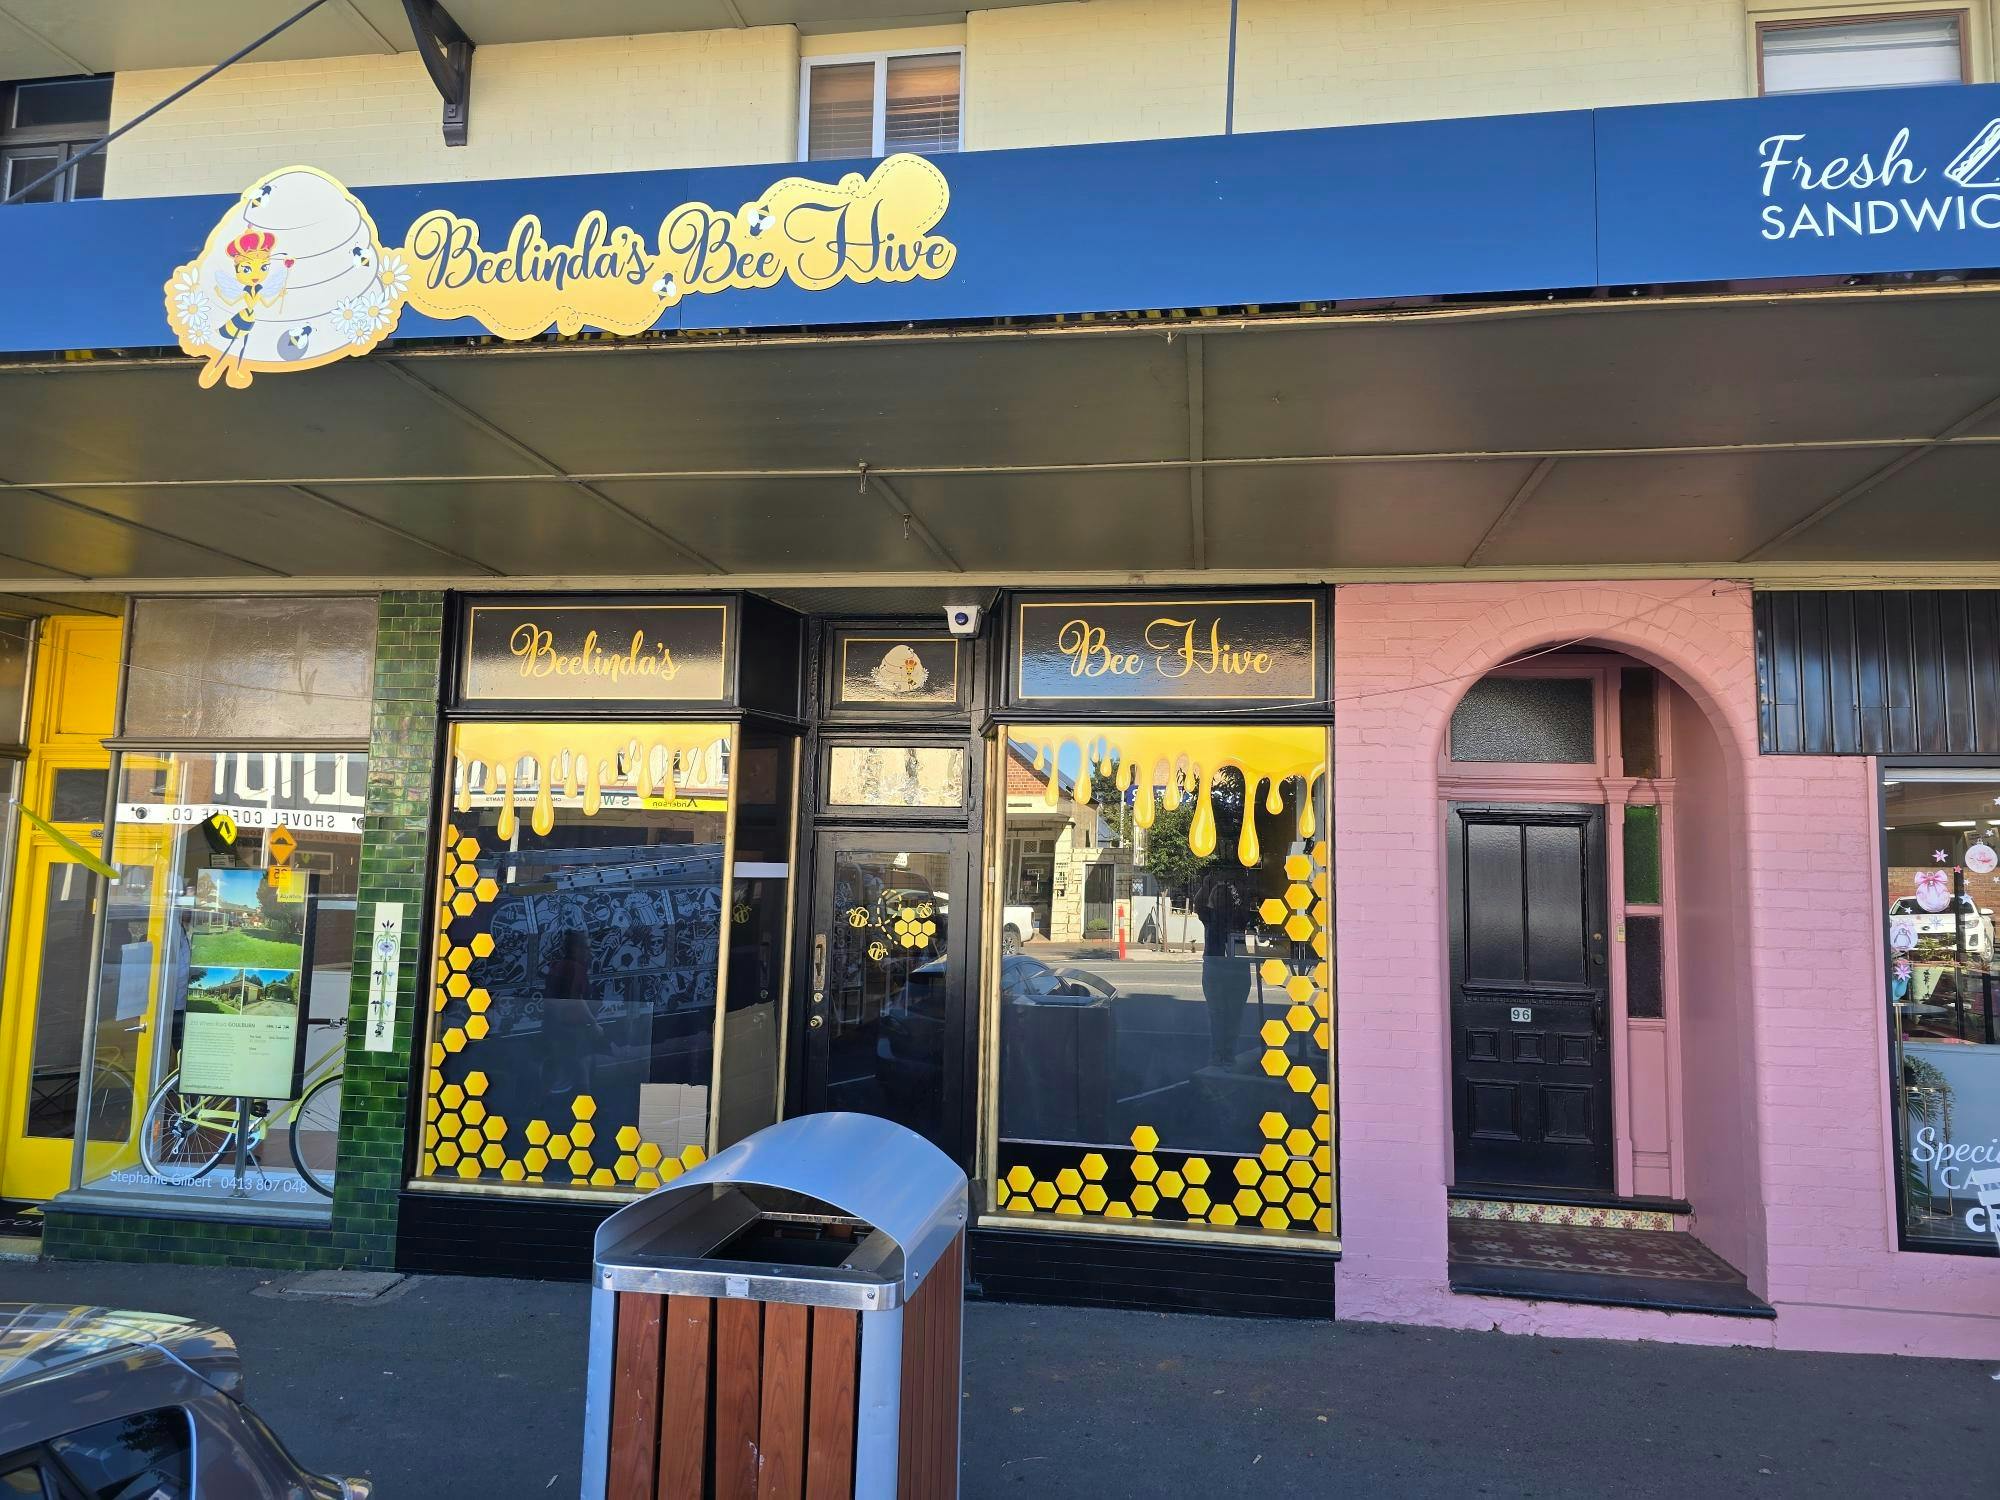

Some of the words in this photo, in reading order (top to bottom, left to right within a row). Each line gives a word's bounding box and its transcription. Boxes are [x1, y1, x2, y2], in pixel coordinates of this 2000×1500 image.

[1759, 127, 1927, 196] Fresh
[1761, 193, 2000, 240] SANDWIC
[413, 212, 653, 292] Beelinda's
[669, 212, 780, 282] Bee
[784, 202, 951, 280] Hive
[510, 623, 682, 683] Beelinda's
[1058, 619, 1144, 677] Bee
[1144, 616, 1273, 678] Hive
[1512, 1009, 1530, 1020] 96
[1912, 1126, 2000, 1171] Speci
[110, 1170, 168, 1185] Stephanie
[171, 1174, 212, 1188] Gilbert
[221, 1176, 253, 1190] 0413
[256, 1178, 279, 1192] 807
[283, 1180, 308, 1194] 048
